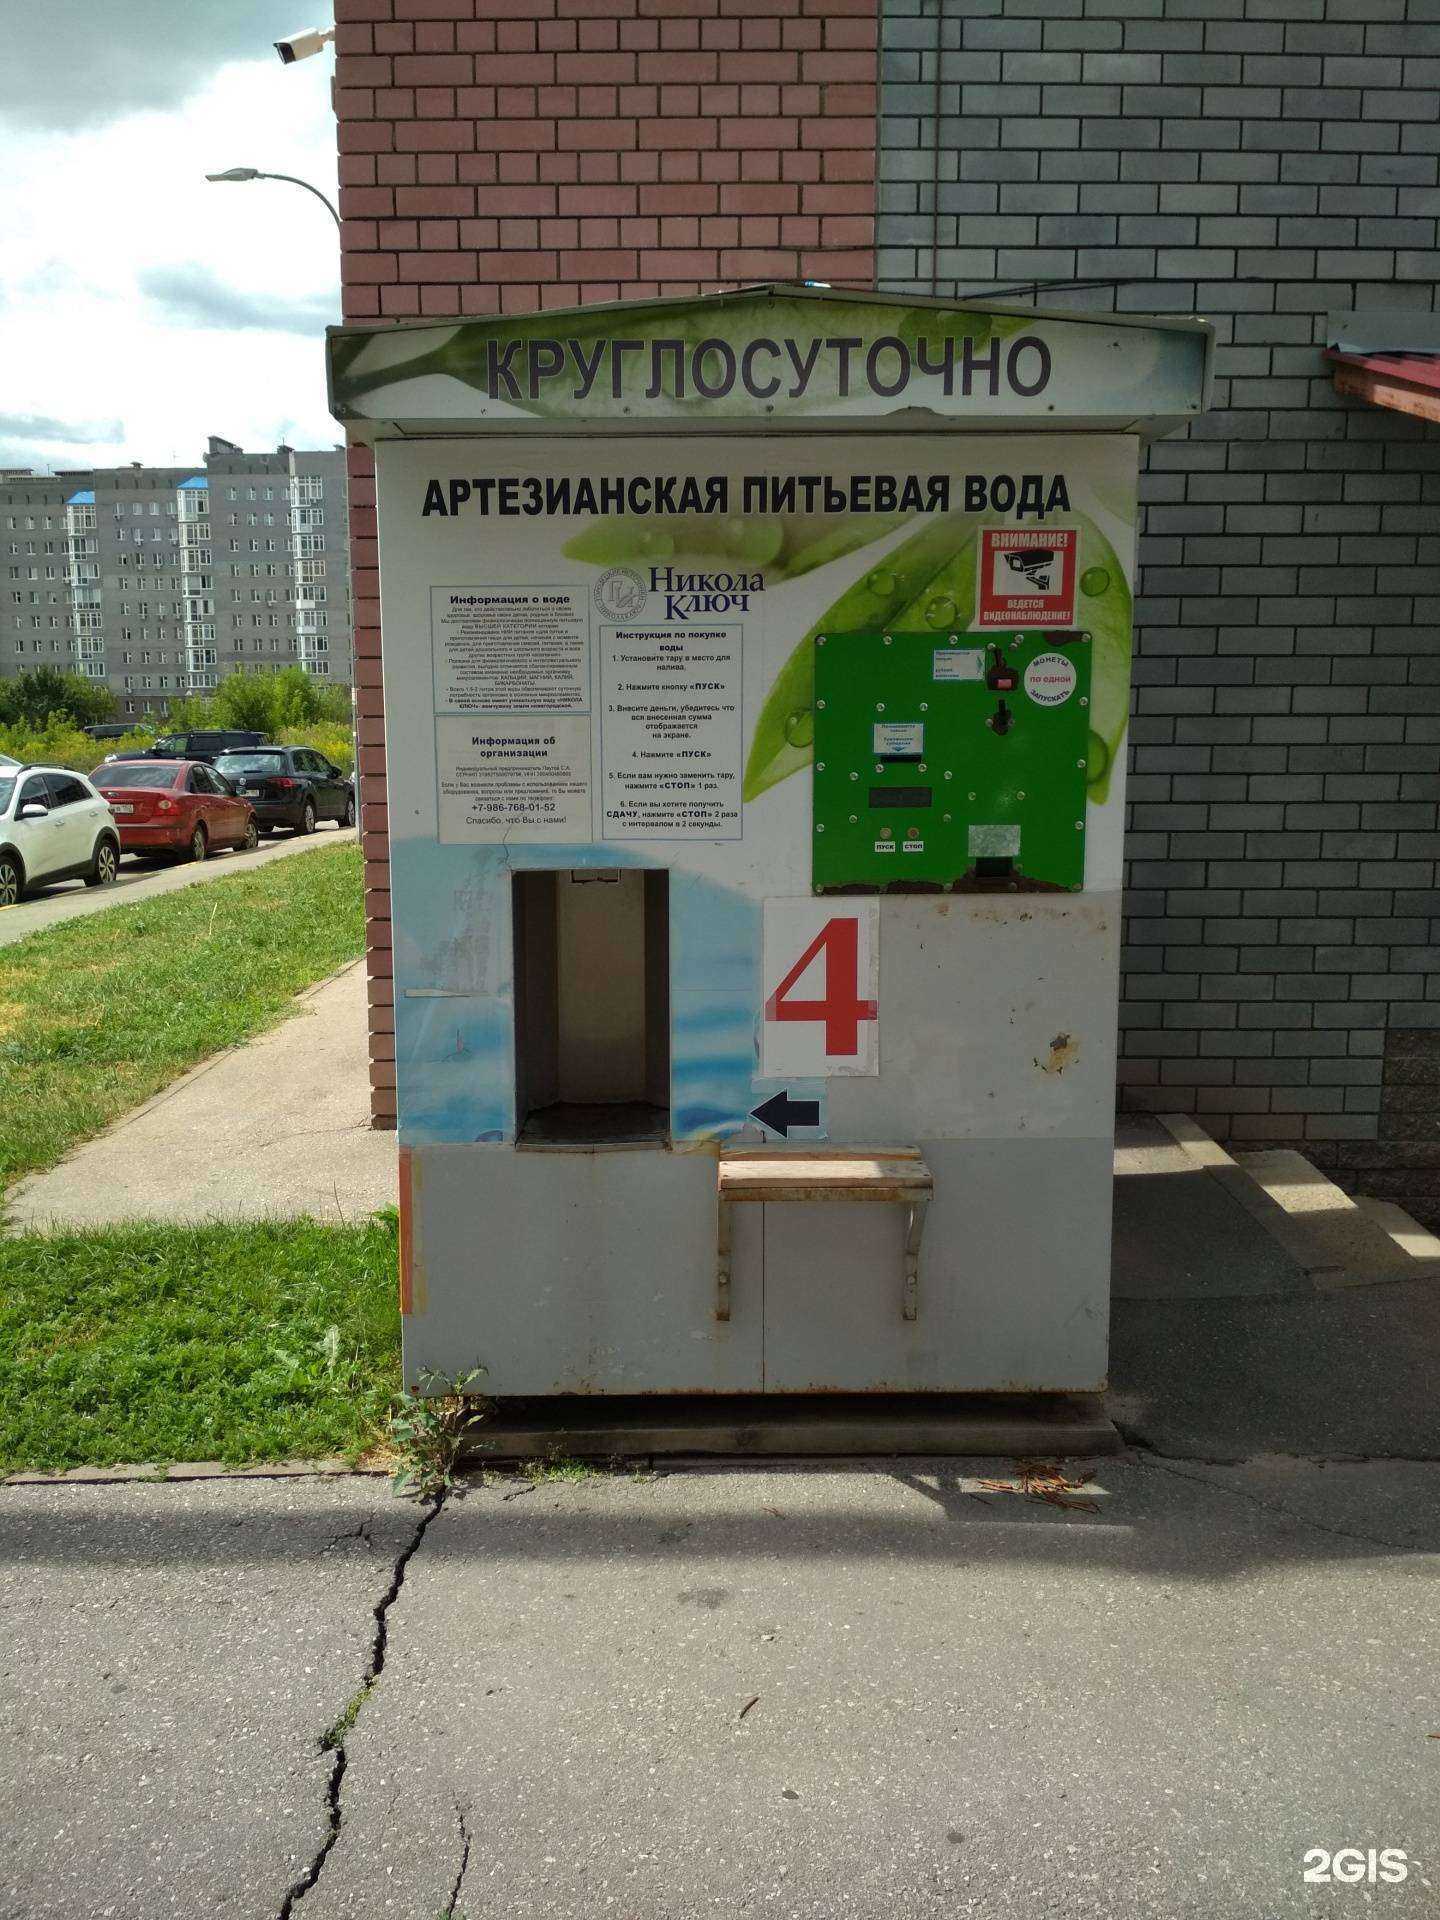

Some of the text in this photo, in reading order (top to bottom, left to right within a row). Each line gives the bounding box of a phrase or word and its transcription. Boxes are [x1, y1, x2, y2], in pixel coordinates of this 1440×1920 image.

[486, 336, 1053, 400] КРУГЛОСУТОЧНО
[422, 474, 1071, 519] АРТЕЗИАНСКАЯ ПИТЬЕВАЯ ВОДА
[991, 533, 1068, 547] ВНИМАНИЕ!
[648, 567, 765, 592] Никола
[450, 596, 528, 605] Информация
[1008, 600, 1044, 609] ВЕДЕТСЯ
[984, 611, 1071, 621] ВИДЕОНАБЛЮДЕНИЕ!
[616, 632, 672, 640] Инструкция
[1034, 657, 1068, 666] МОНЕТЫ
[1031, 689, 1070, 701] ЗАПУСКАТЬ
[472, 737, 539, 746] Информация
[472, 803, 555, 811] +7-986-768-01-52
[765, 917, 878, 1056] 4
